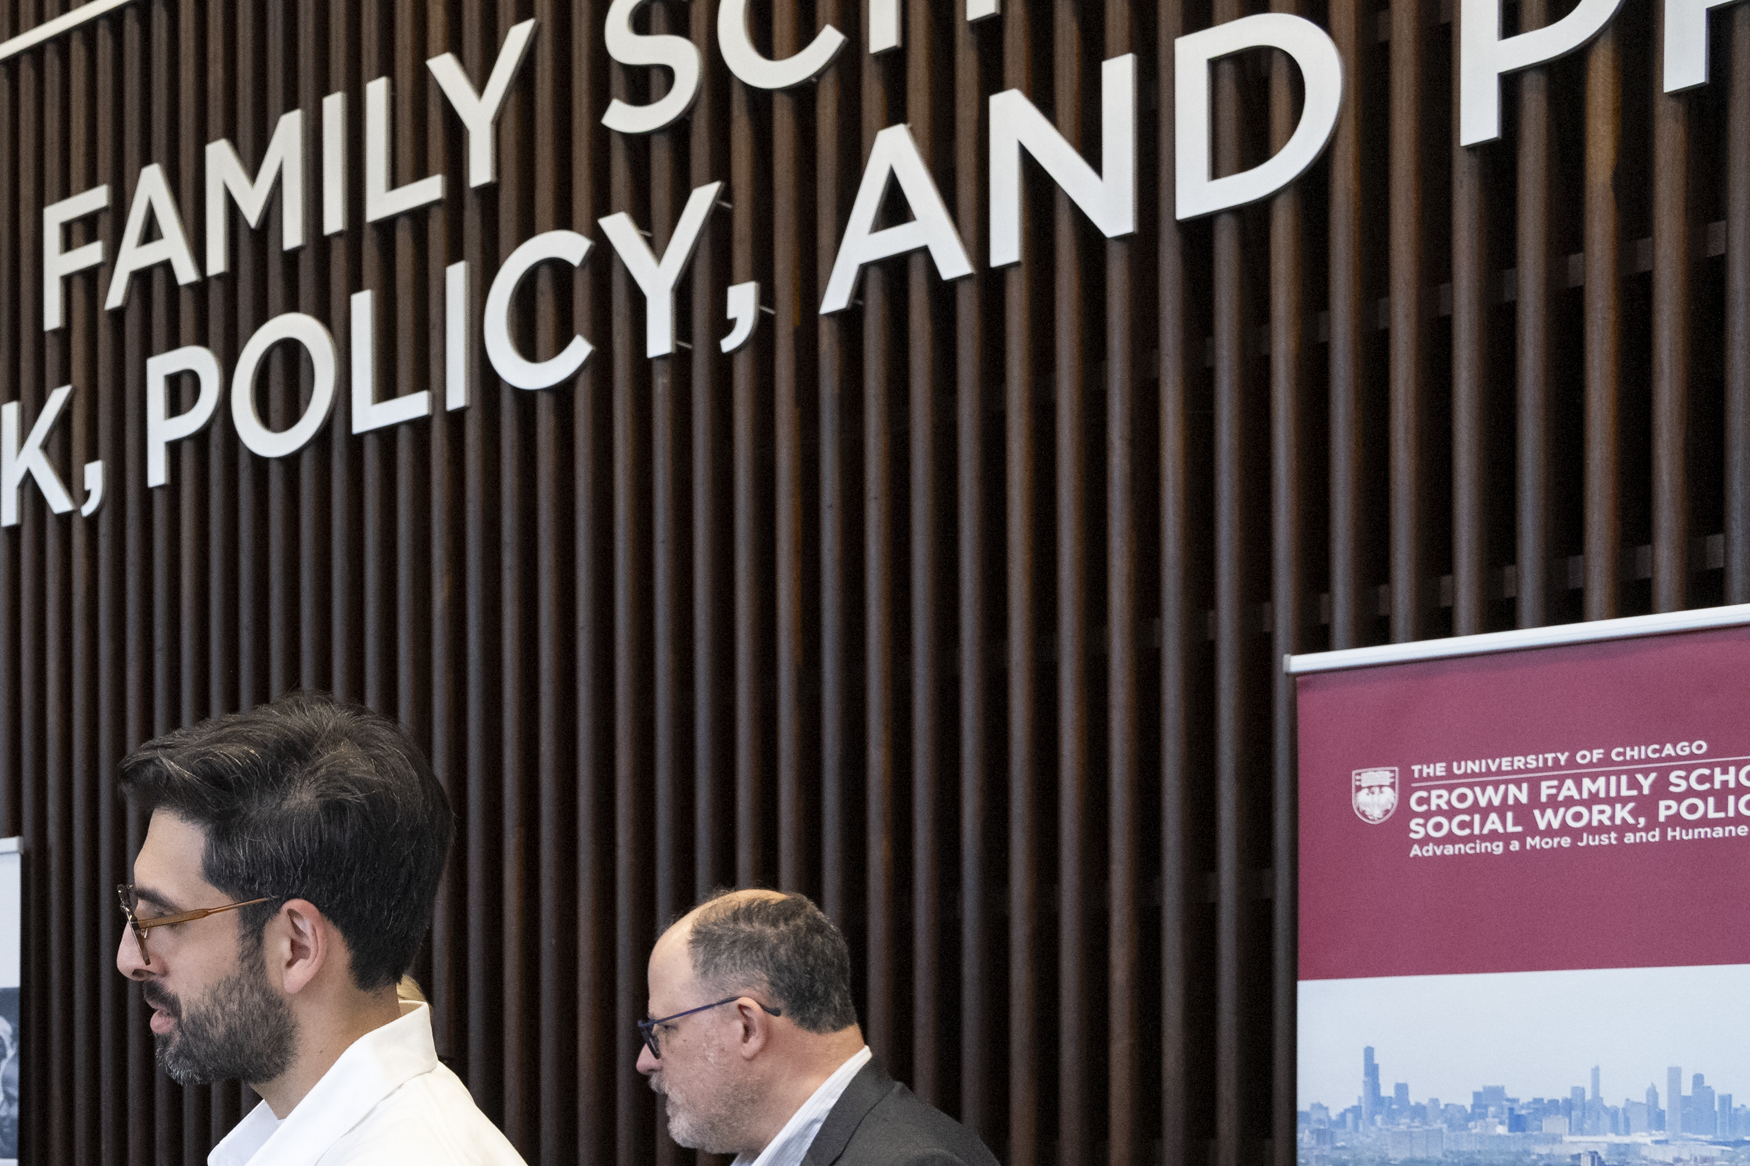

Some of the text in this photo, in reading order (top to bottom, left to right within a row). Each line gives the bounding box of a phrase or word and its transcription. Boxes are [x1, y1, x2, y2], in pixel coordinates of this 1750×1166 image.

[44, 18, 537, 332] FAMILY
[147, 181, 757, 488] POLICY,
[819, 53, 1343, 315] AND
[1411, 740, 1708, 778] THE UNIVERSITY OF CHICAGO
[1409, 783, 1529, 813] CROWN
[1540, 772, 1658, 803] FAMILY
[1408, 811, 1523, 840] SOCIAL
[1533, 802, 1646, 831] WORK,
[1409, 824, 1749, 858] Advancing a More Just and Humane
